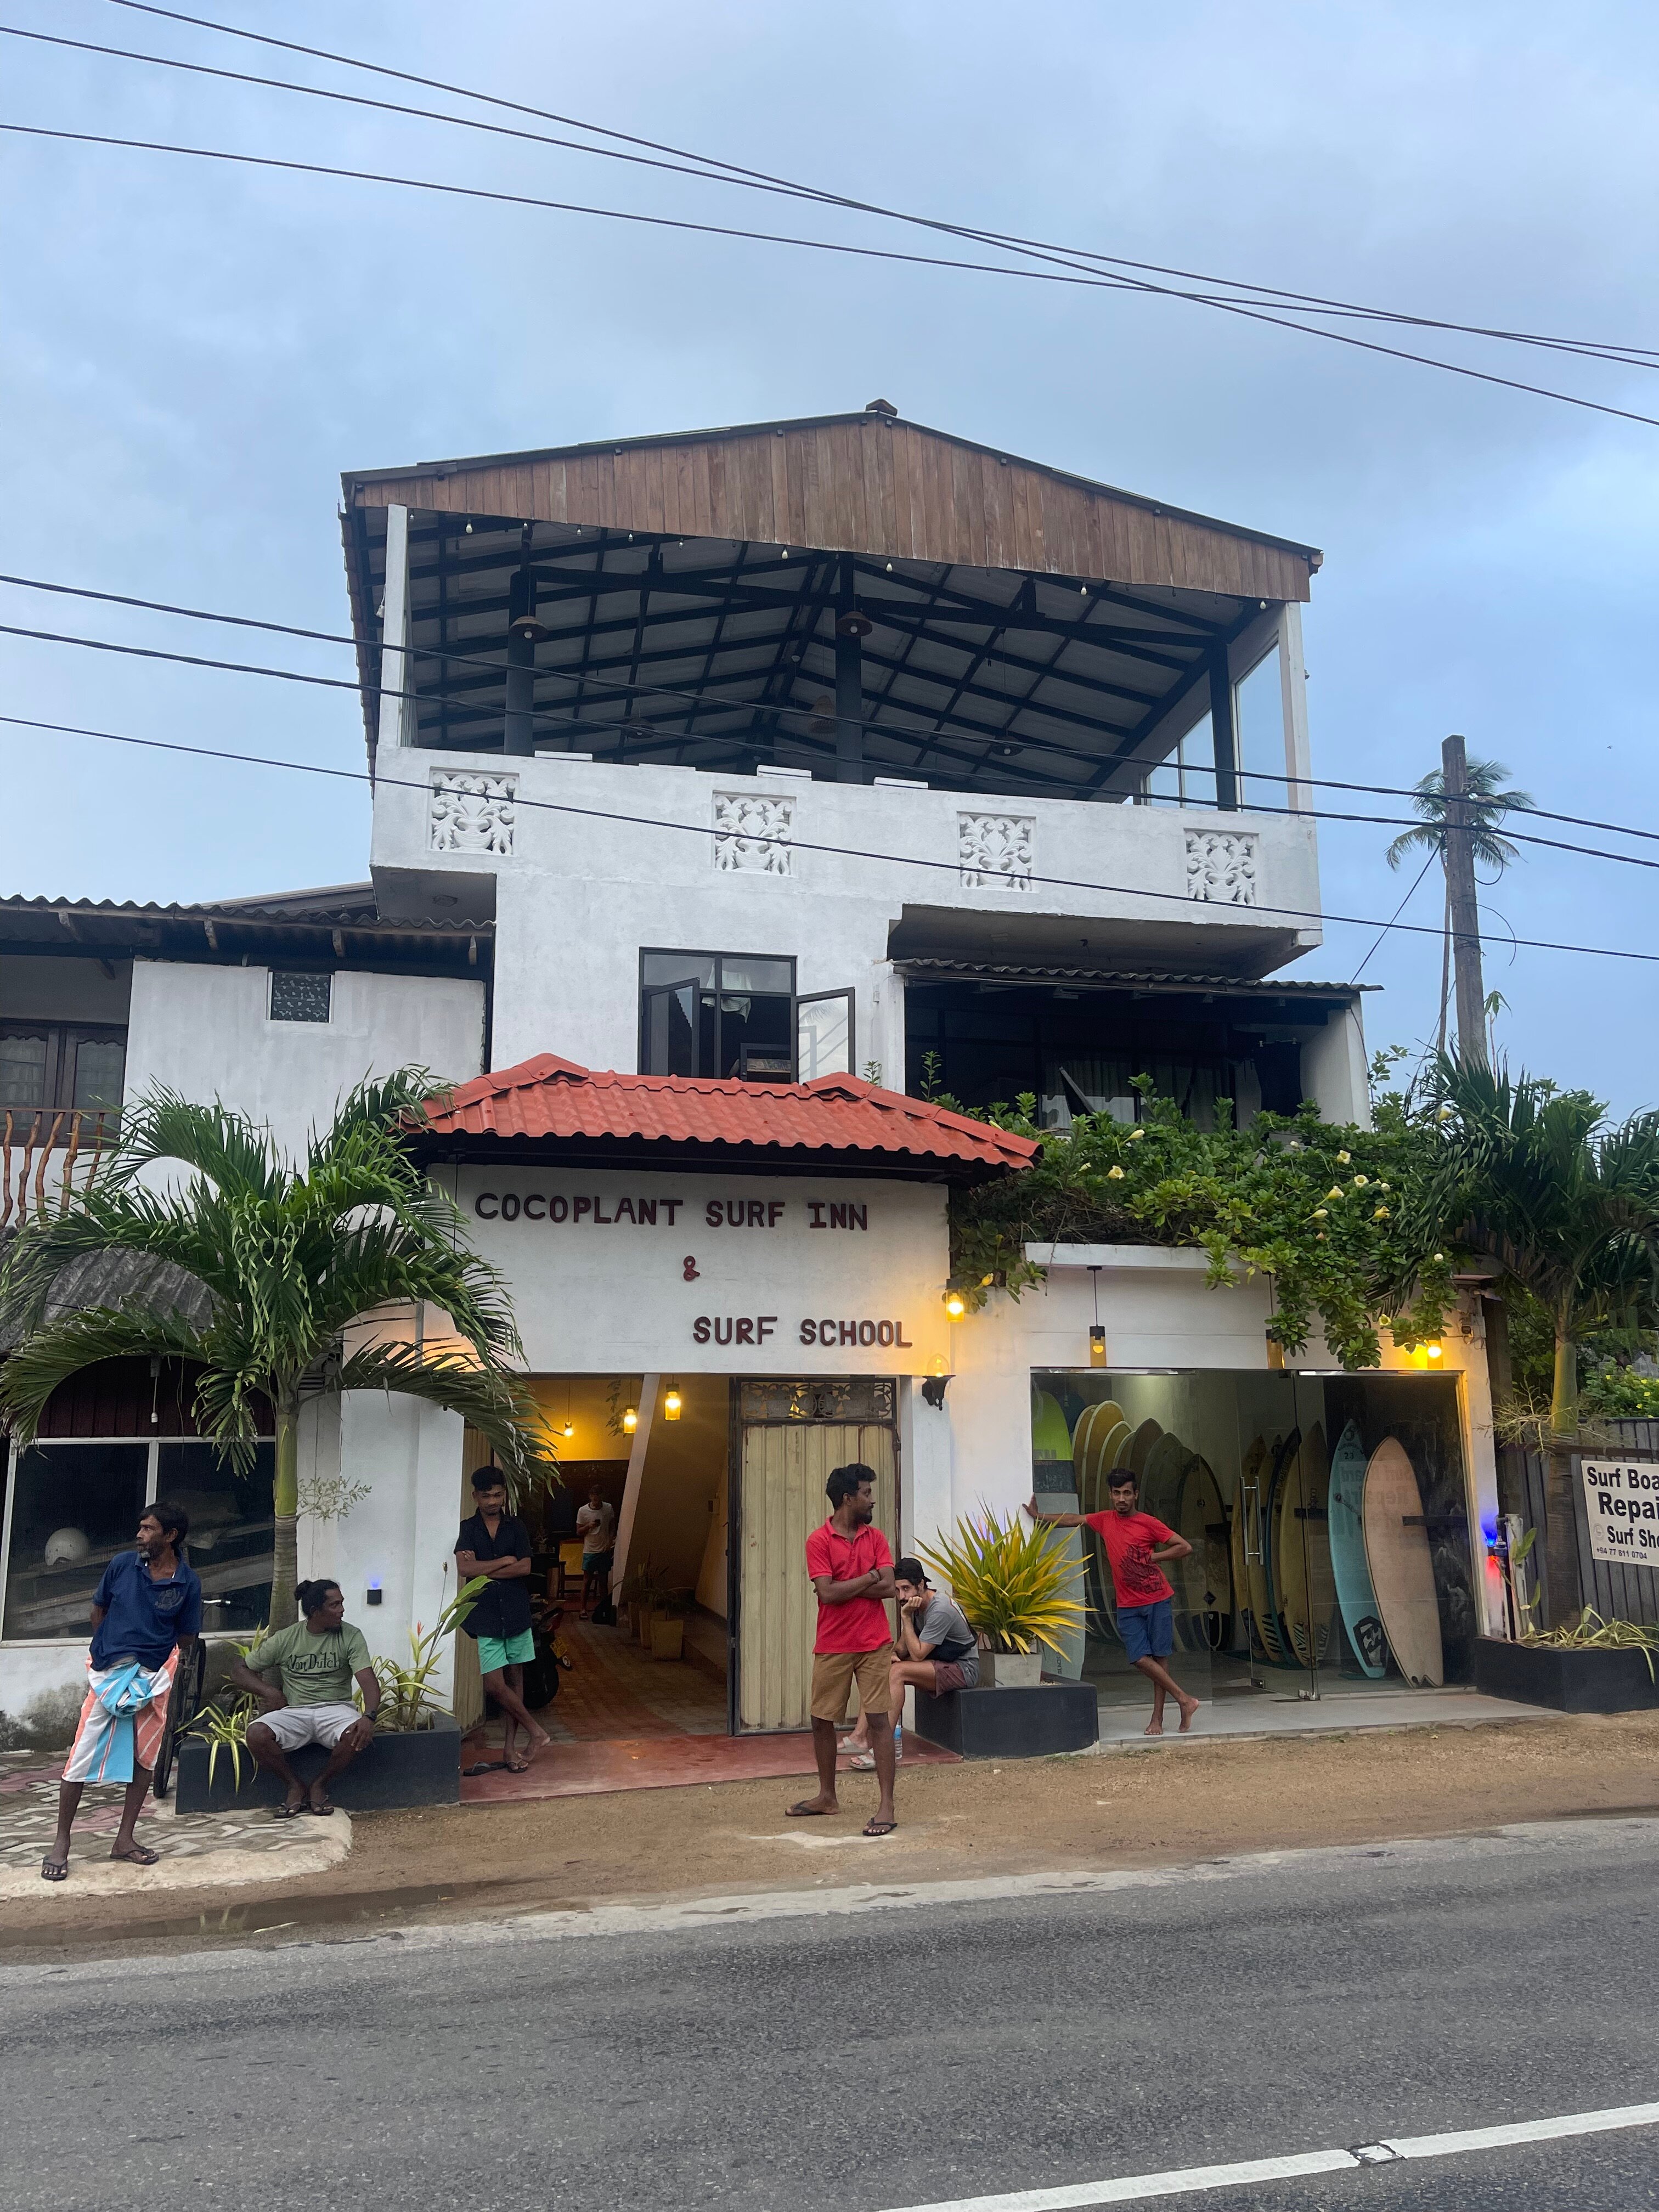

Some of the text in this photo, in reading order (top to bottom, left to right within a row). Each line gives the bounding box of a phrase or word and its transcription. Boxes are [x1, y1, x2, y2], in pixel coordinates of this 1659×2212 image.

[475, 1193, 867, 1231] COCOPLANT SURF INN
[682, 1255, 700, 1282] &
[693, 1316, 913, 1347] SURF SCHOOL
[1587, 1466, 1621, 1487] Surf
[1607, 1525, 1633, 1545] Surf
